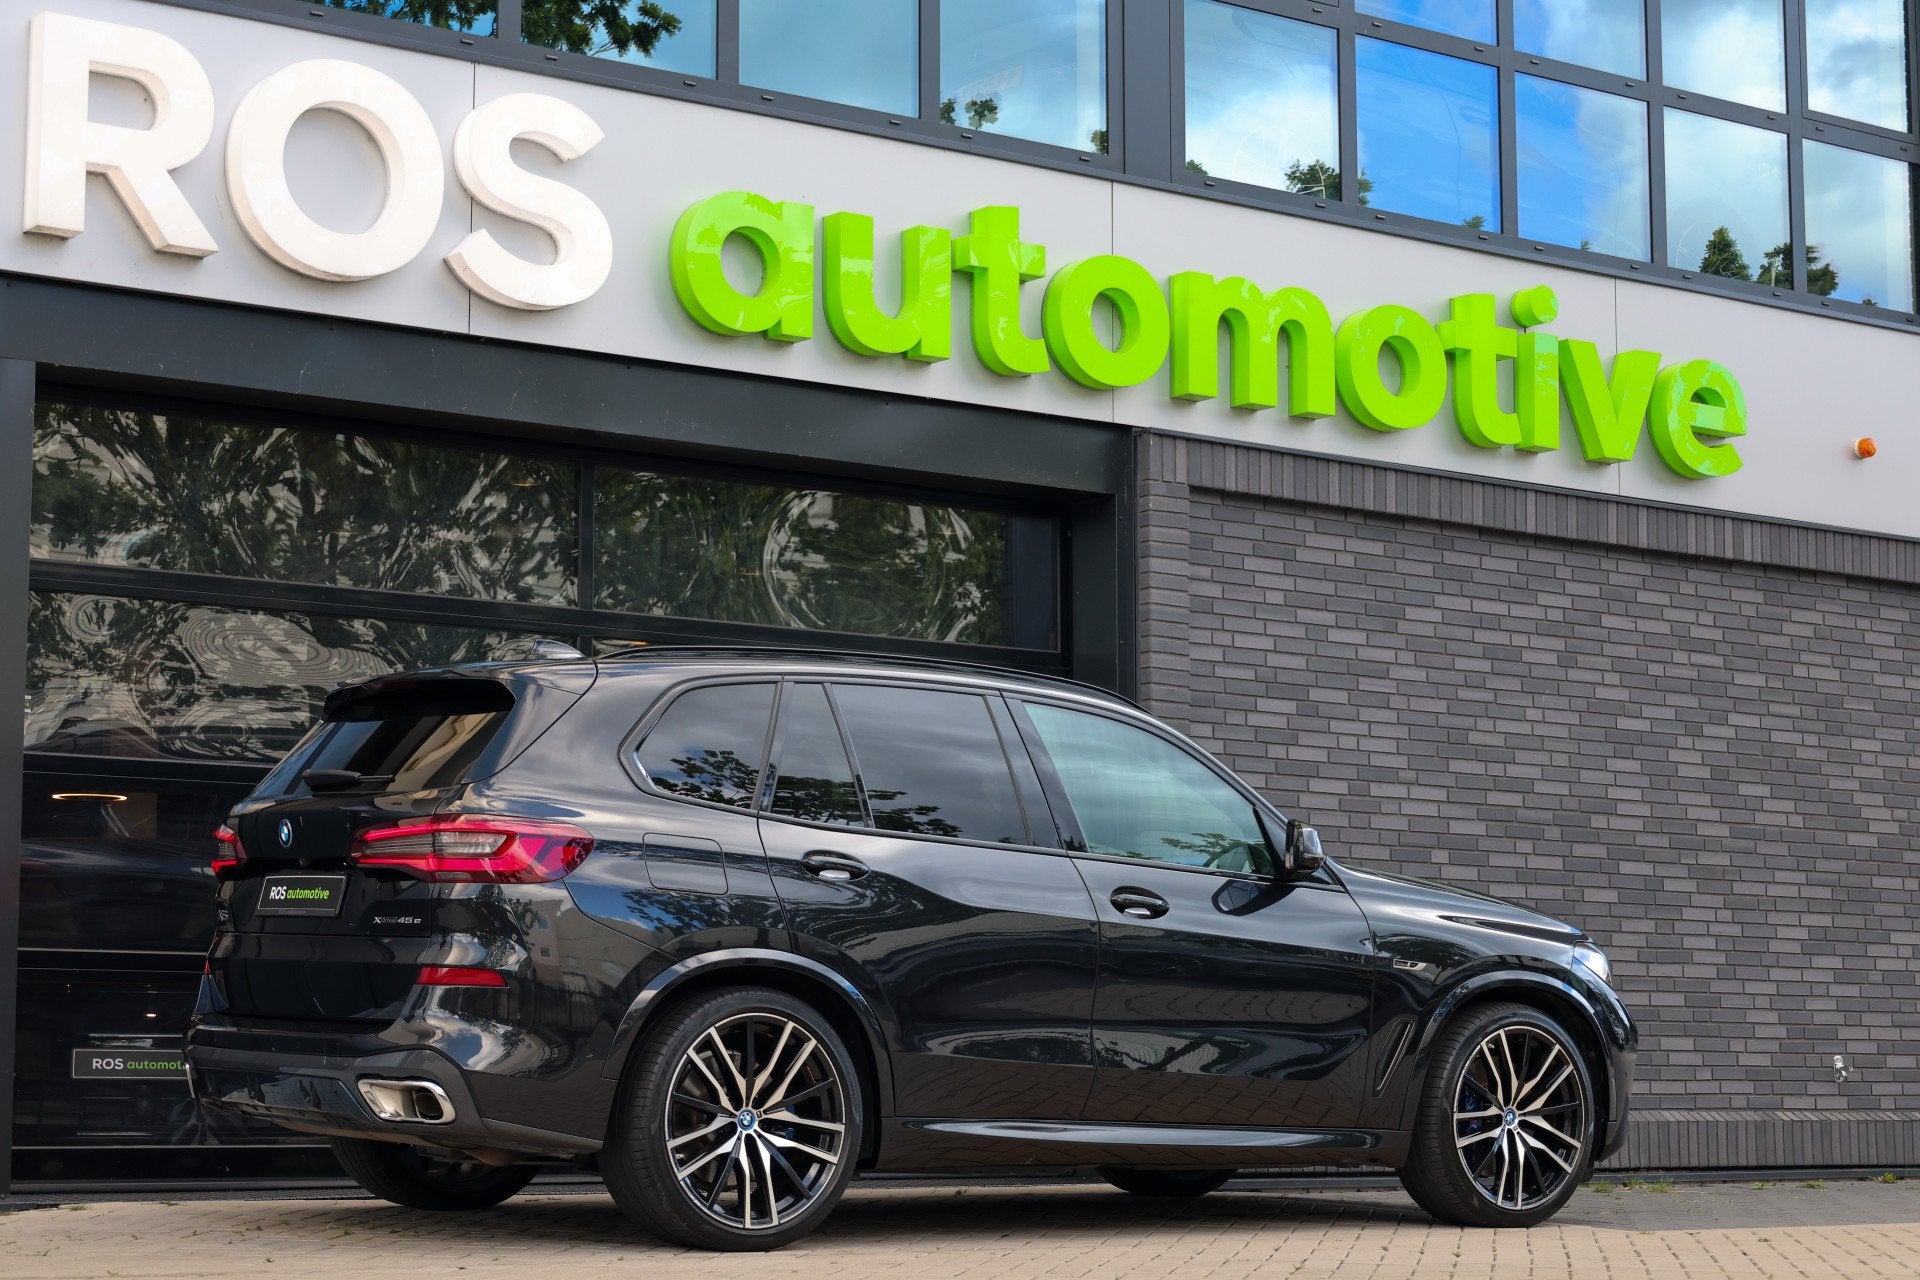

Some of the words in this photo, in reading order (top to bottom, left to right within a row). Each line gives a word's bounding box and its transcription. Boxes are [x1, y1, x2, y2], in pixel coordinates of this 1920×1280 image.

[23, 12, 613, 311] ROS
[669, 190, 1747, 479] automotive
[269, 886, 287, 900] ROS
[287, 887, 330, 899] automotive
[92, 1058, 124, 1070] ROS
